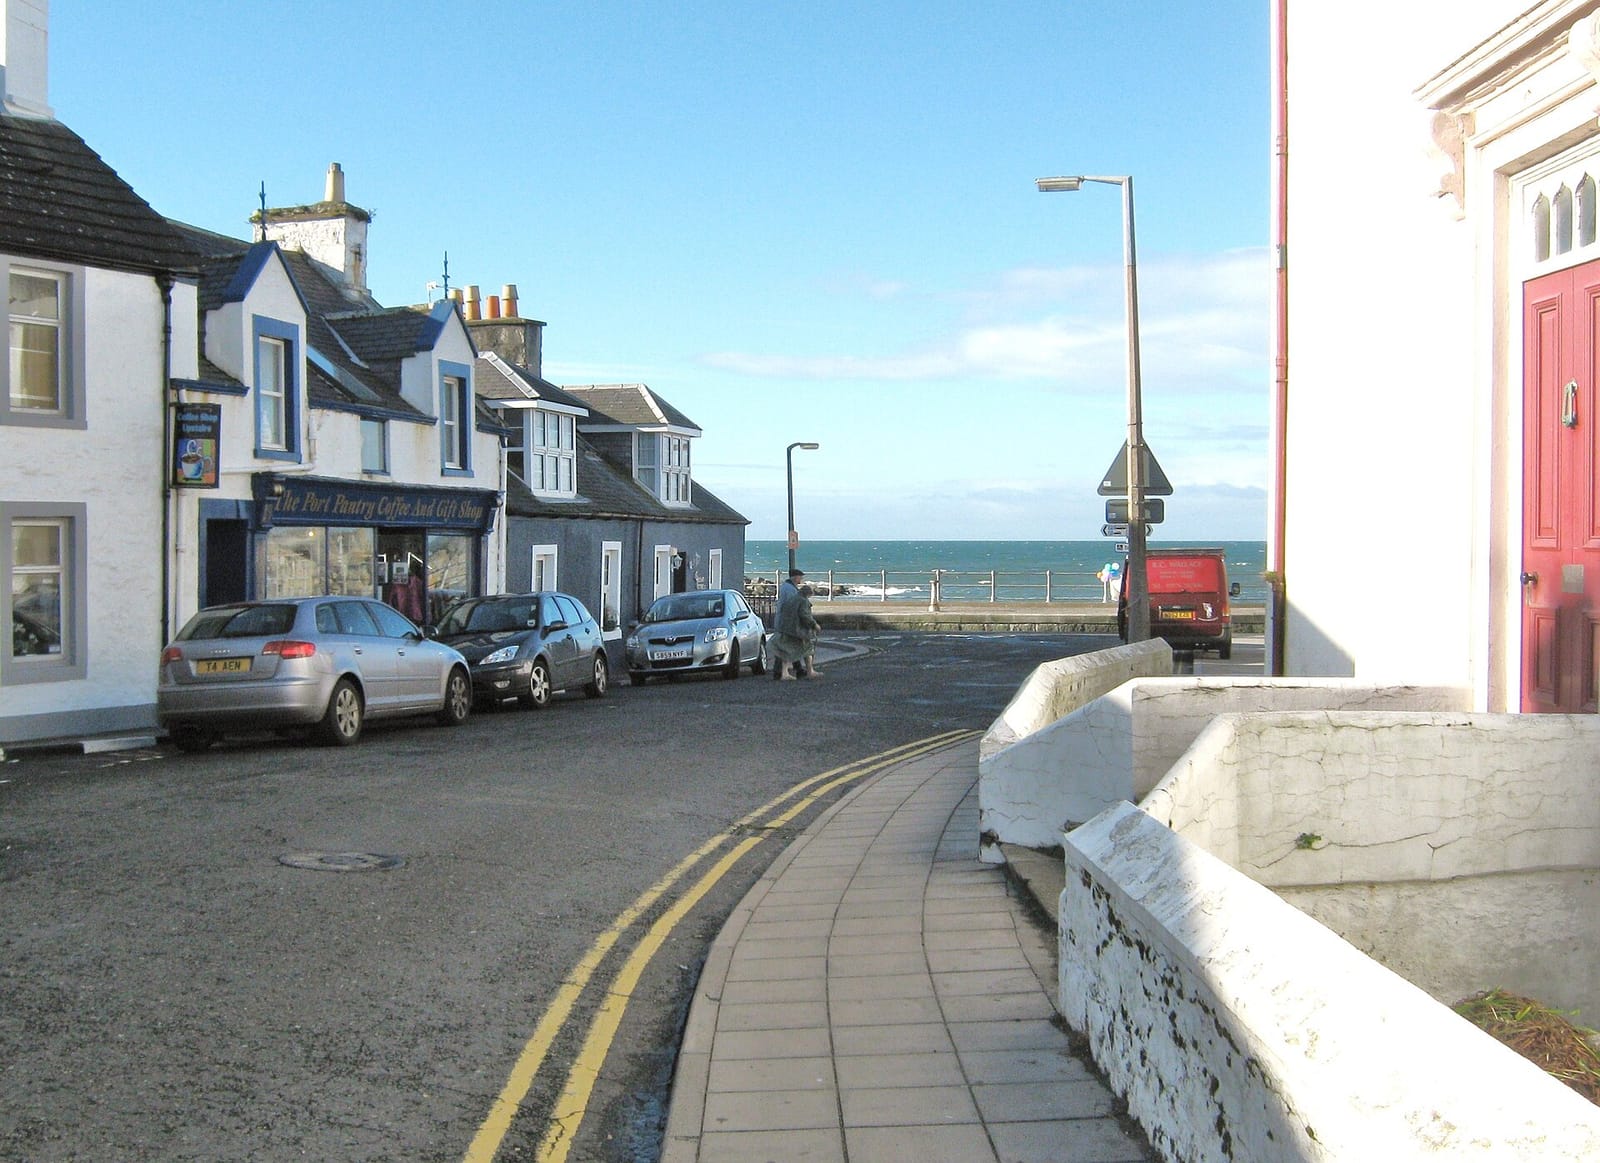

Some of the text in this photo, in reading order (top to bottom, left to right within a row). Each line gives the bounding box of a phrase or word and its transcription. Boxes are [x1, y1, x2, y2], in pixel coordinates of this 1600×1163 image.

[274, 489, 483, 521] The Port Pantry Coffee And Gift Shop
